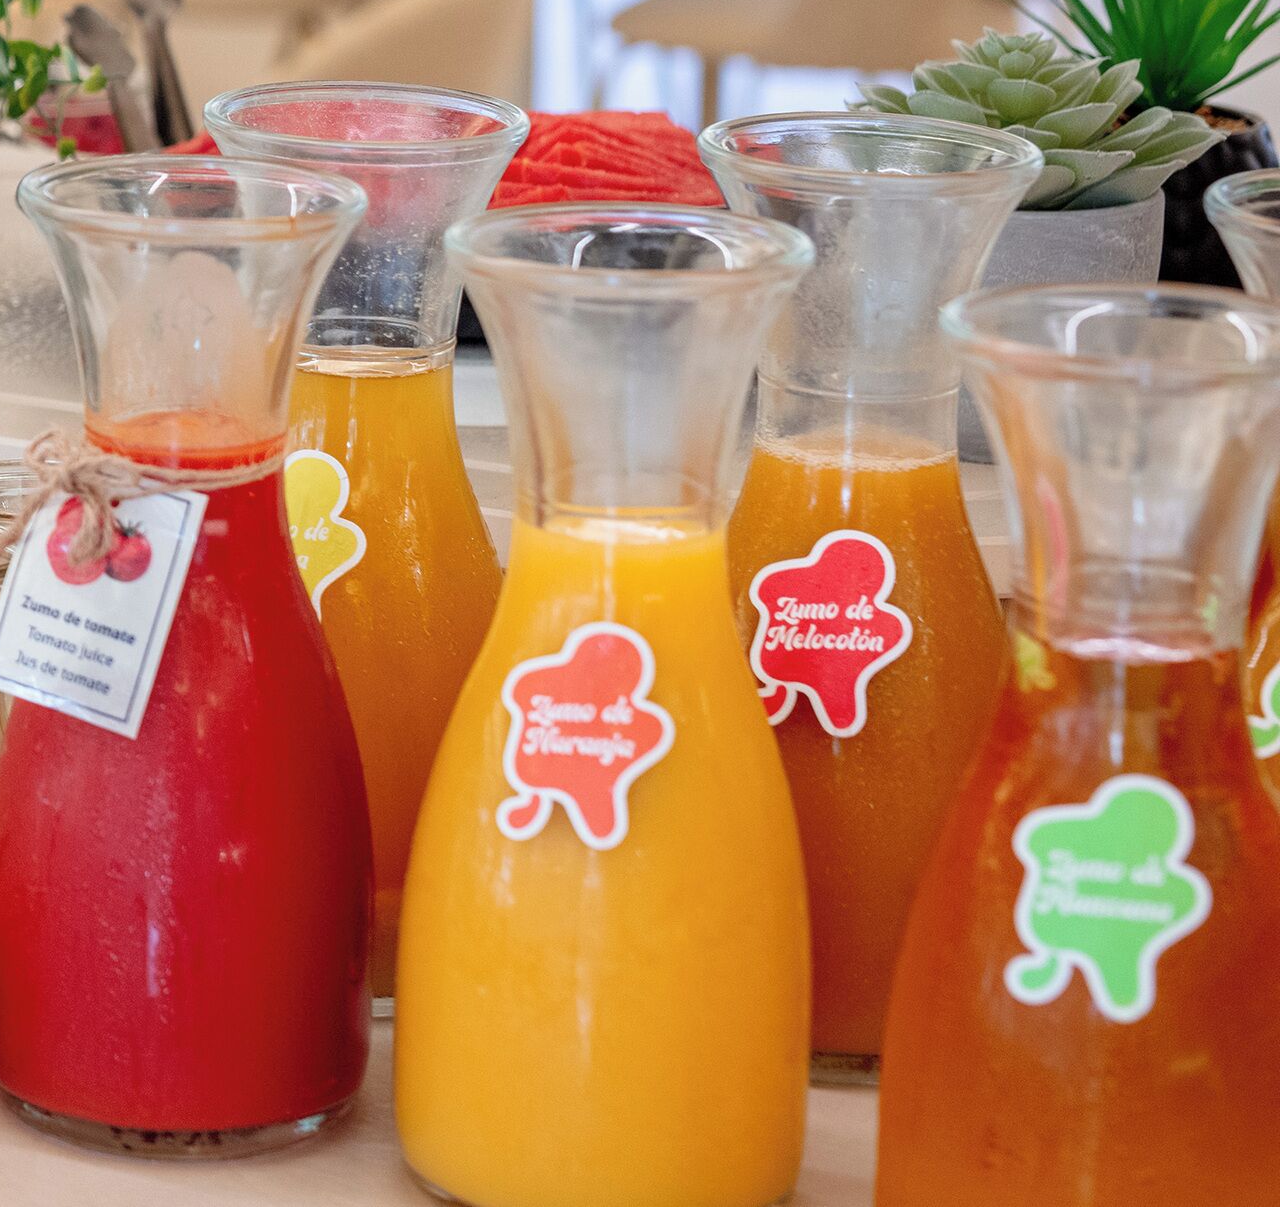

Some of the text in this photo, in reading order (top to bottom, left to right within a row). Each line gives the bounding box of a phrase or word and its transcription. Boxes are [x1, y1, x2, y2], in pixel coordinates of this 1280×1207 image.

[303, 517, 330, 542] de
[21, 594, 136, 645] Zumo de tomate
[774, 595, 874, 625] Zumo de
[28, 624, 114, 667] Tomato juice
[764, 624, 884, 652] Melocotón
[15, 650, 110, 695] Jus de tomate
[527, 694, 634, 727] Zumo de
